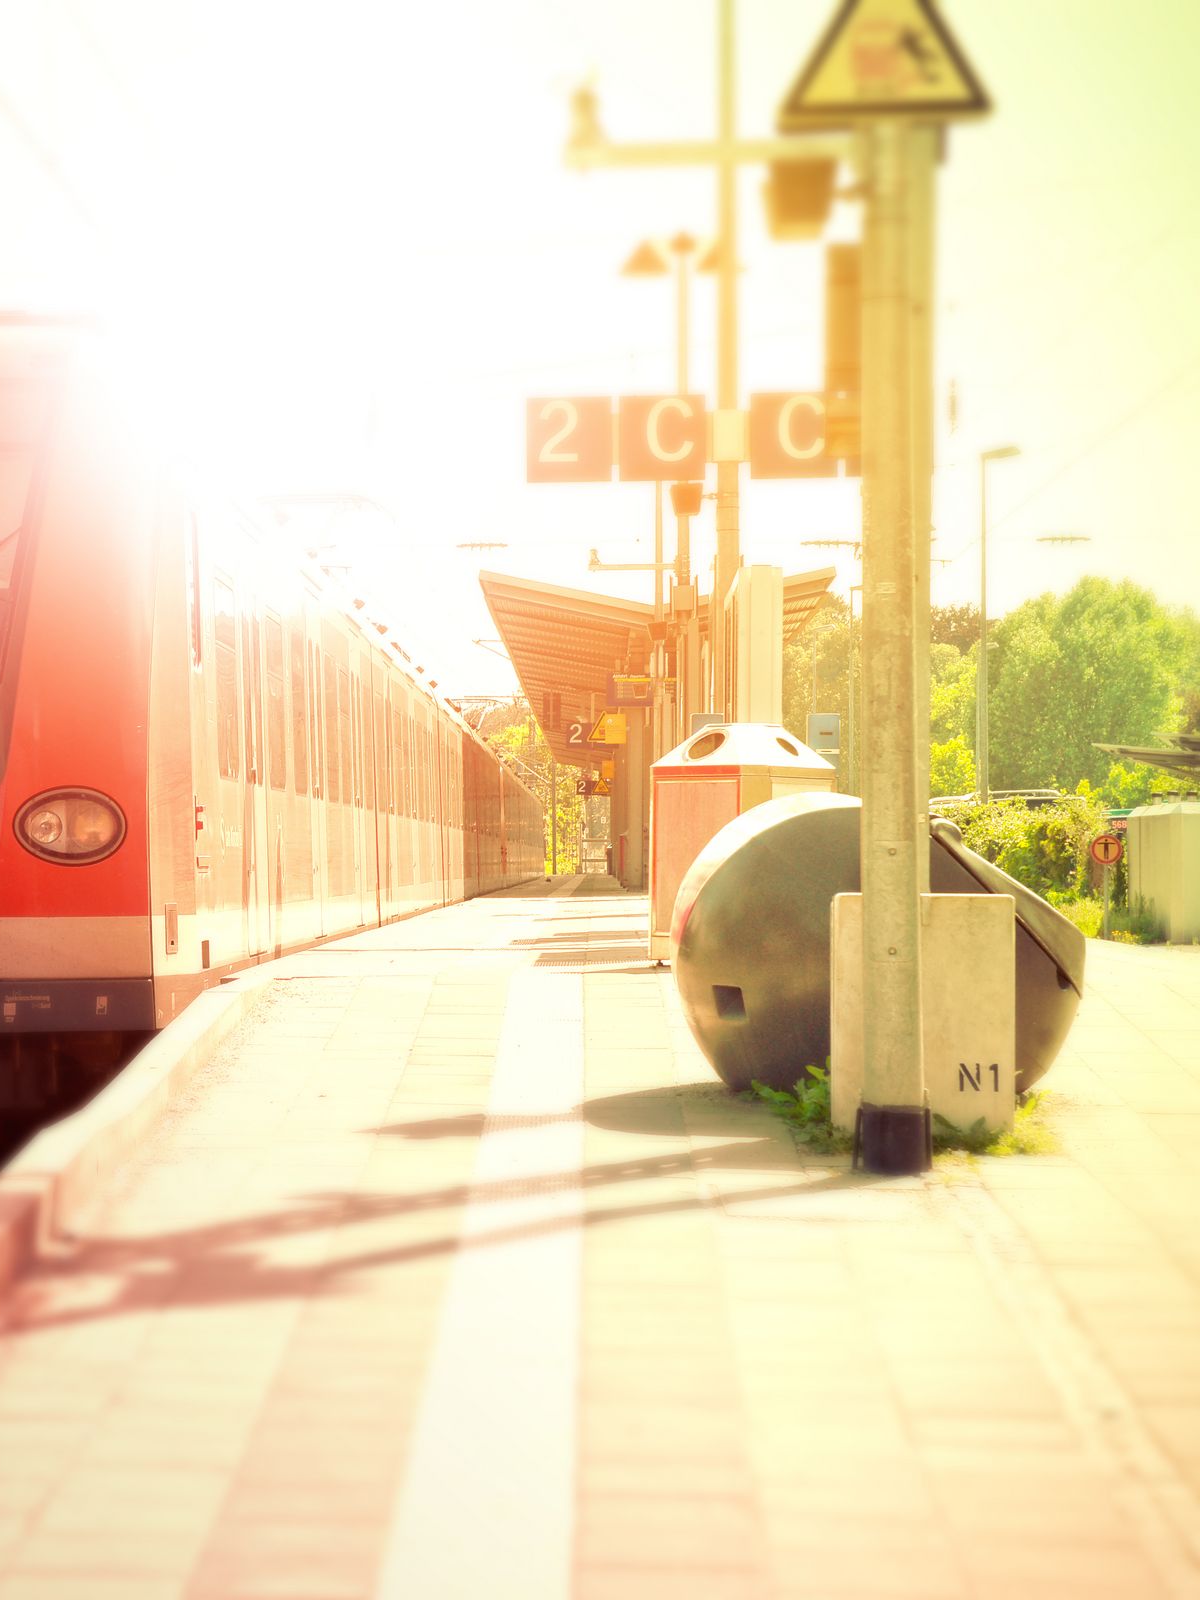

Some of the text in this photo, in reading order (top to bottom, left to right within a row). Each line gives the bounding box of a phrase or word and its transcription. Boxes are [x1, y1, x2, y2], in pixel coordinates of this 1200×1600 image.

[538, 398, 694, 462] 2 C
[778, 395, 826, 459] C
[569, 724, 582, 743] 2
[578, 781, 586, 793] 2
